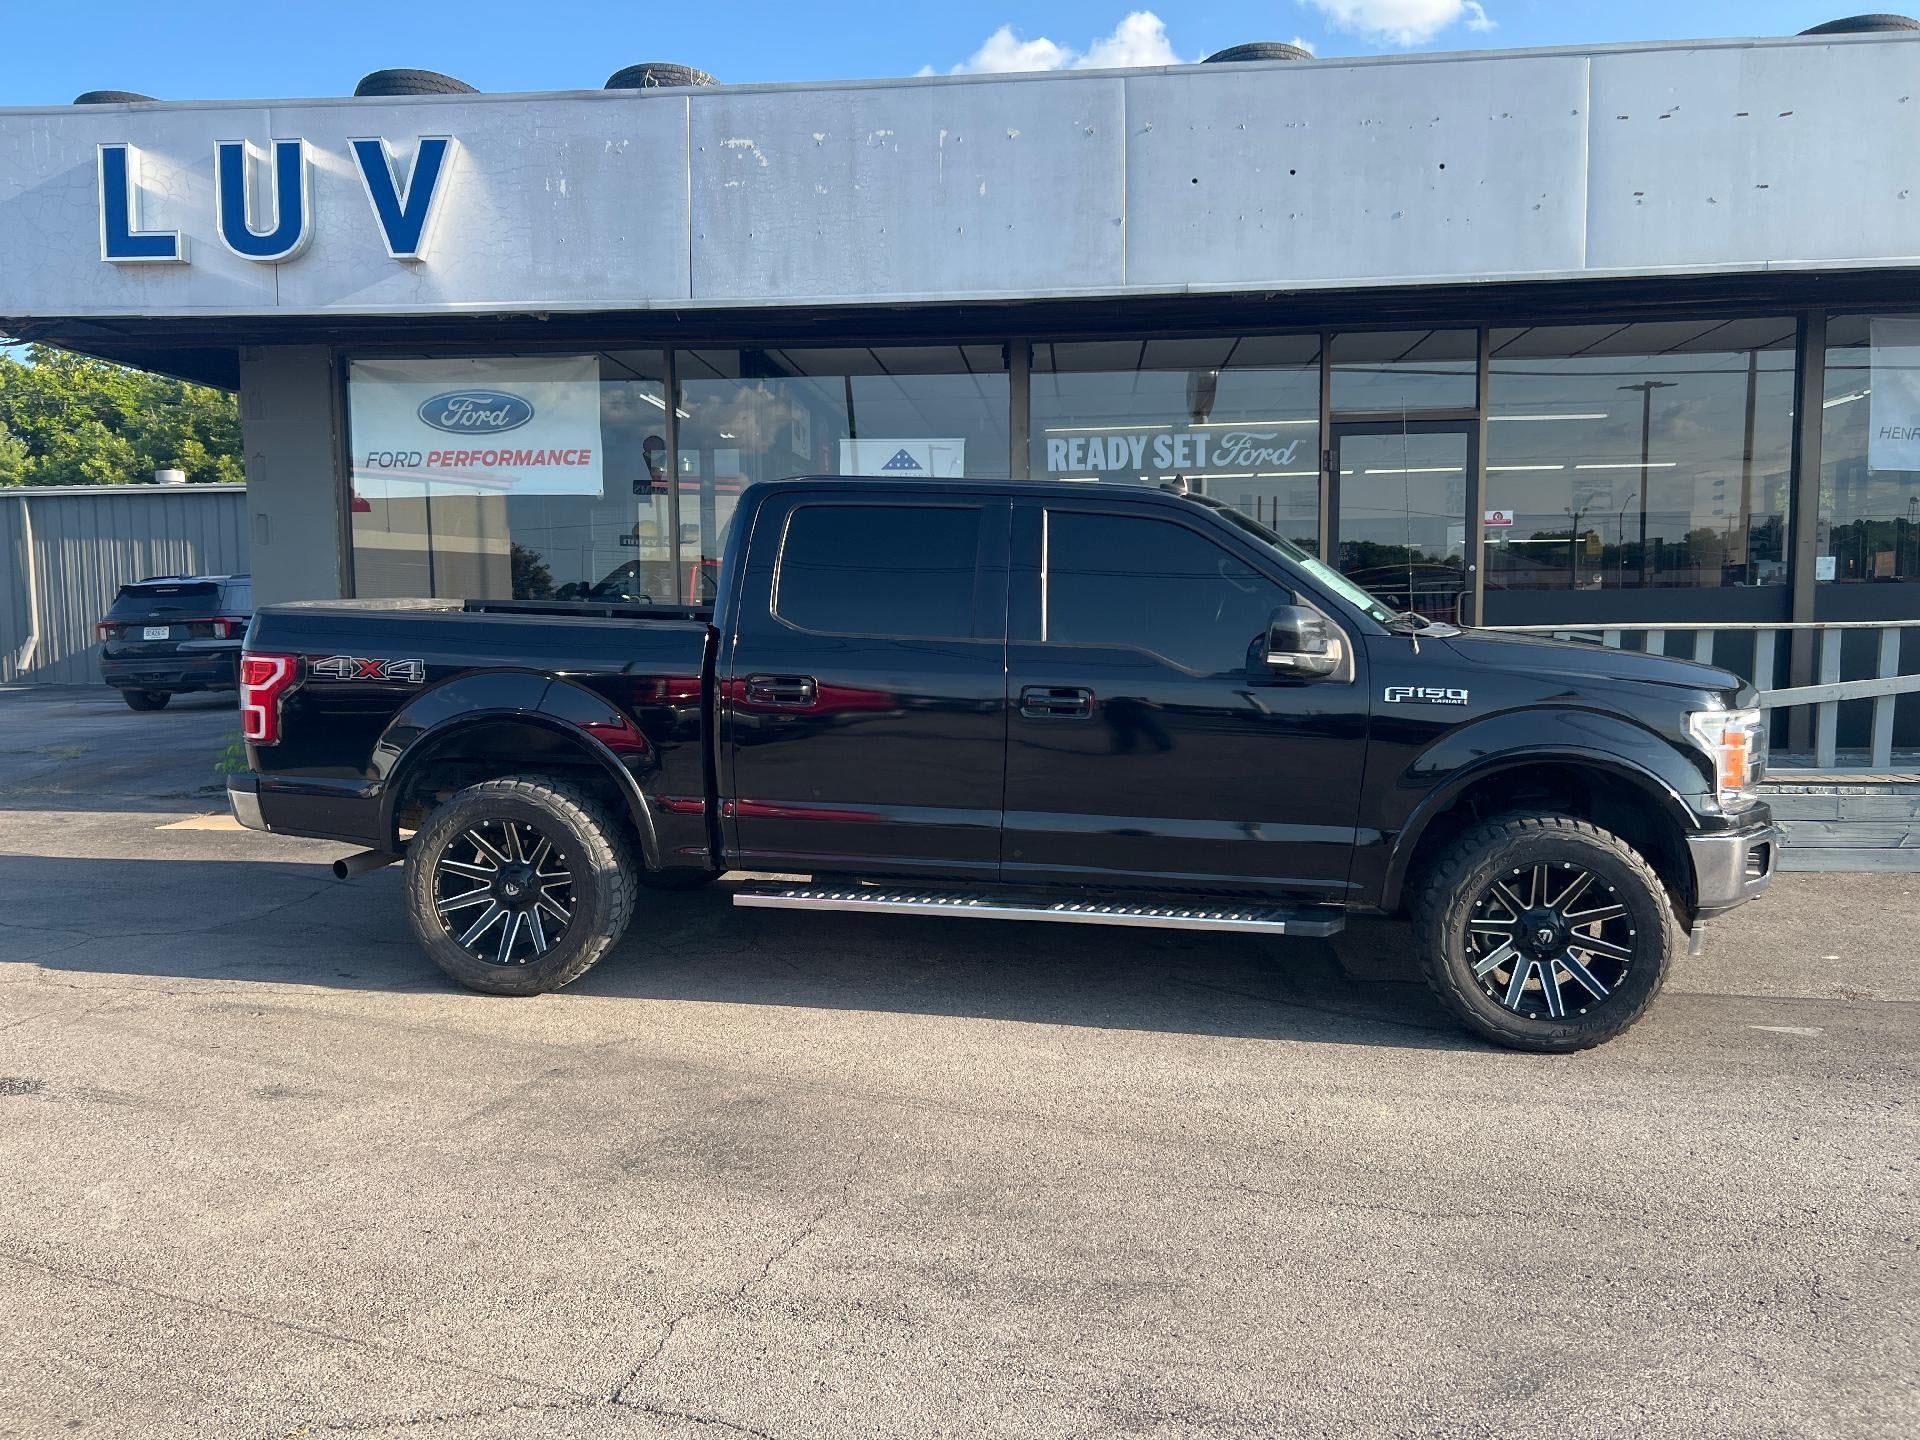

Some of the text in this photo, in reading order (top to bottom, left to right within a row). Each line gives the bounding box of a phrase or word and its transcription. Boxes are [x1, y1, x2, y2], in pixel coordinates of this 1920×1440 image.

[97, 136, 462, 264] LUV
[441, 397, 511, 427] Ford
[366, 449, 592, 468] FORD PERFORMANCE
[1047, 434, 1148, 472] READY
[1152, 432, 1211, 469] SET
[1212, 431, 1298, 467] Ford
